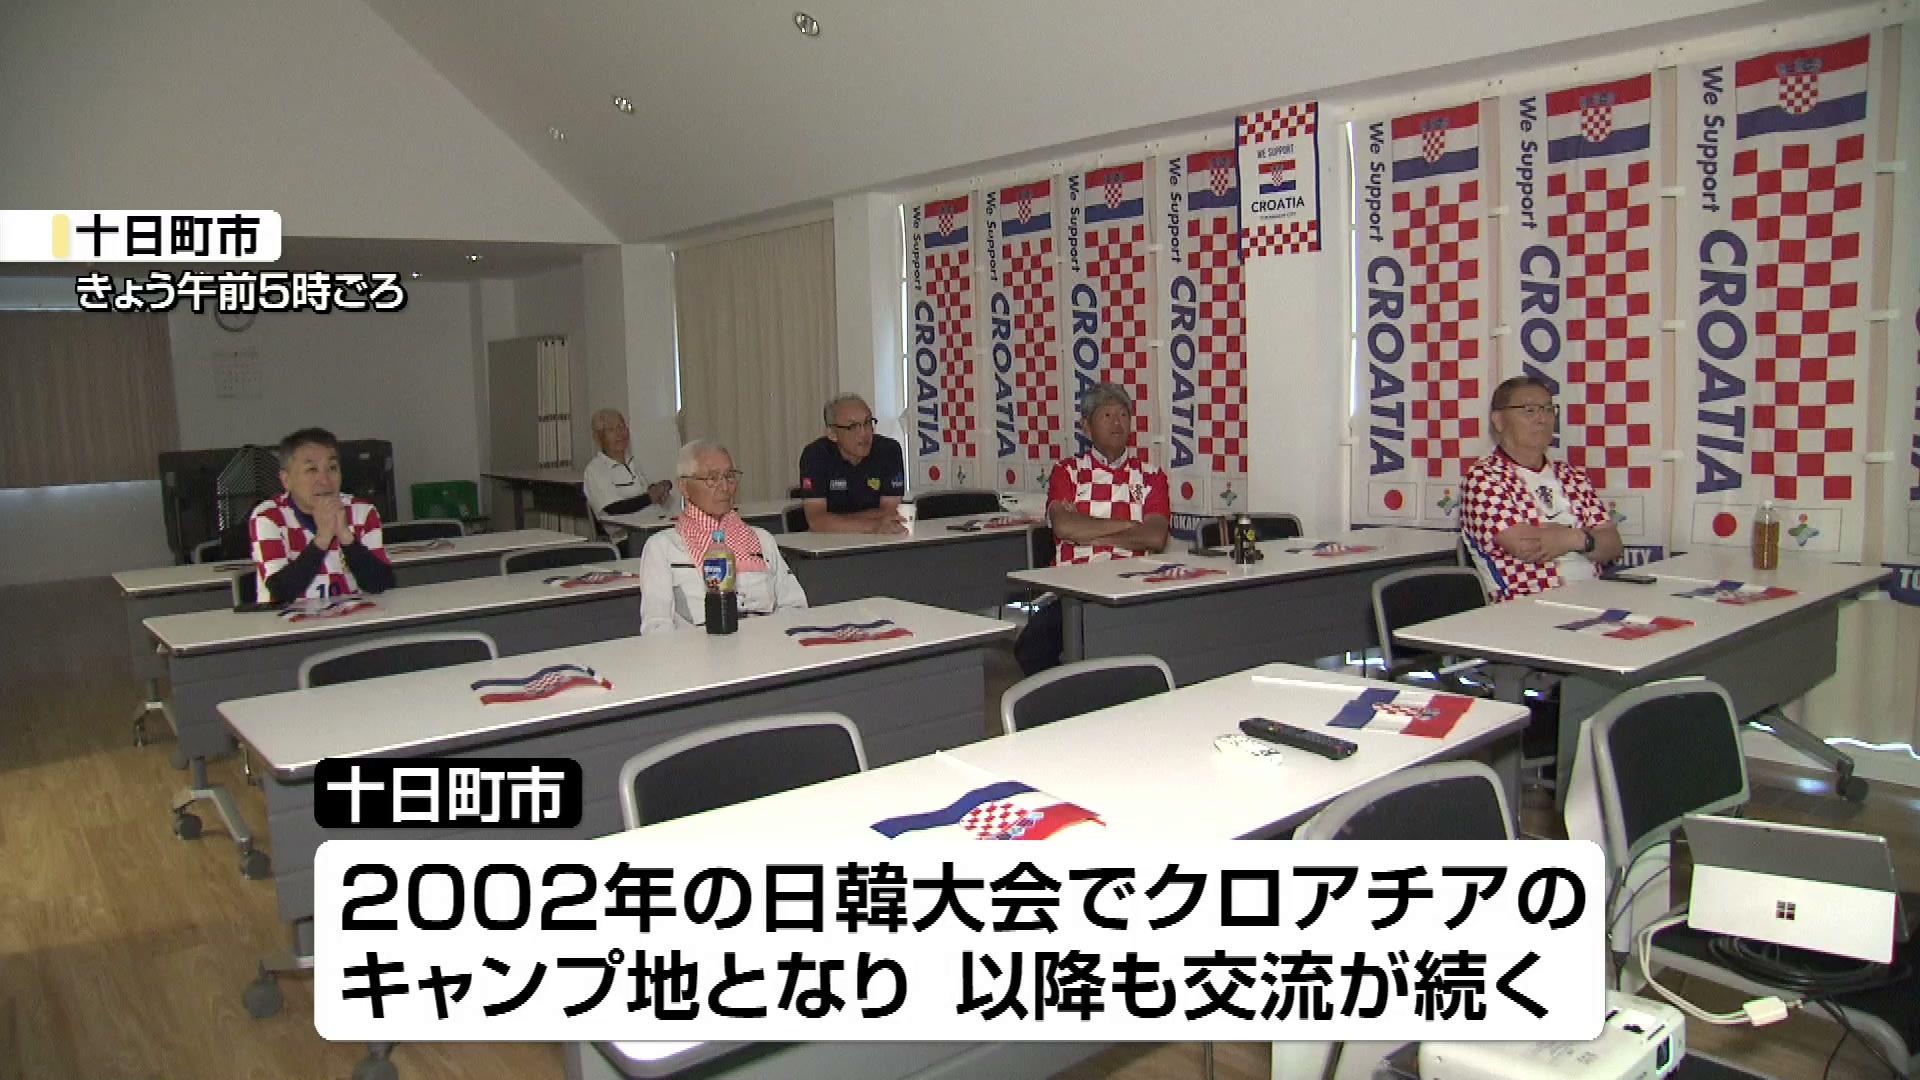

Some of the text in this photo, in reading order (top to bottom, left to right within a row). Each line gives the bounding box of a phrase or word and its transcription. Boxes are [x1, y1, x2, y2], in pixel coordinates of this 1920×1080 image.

[1251, 195, 1306, 213] CROATIA
[1365, 121, 1386, 242] We Support
[1515, 96, 1538, 230] We Support
[1696, 65, 1726, 213] We Support
[986, 191, 998, 282] We Support
[1067, 175, 1081, 272] We Support
[1167, 156, 1182, 264] We Support
[914, 300, 940, 457] CROATIA
[990, 291, 1017, 458] CROATIA
[1170, 275, 1197, 469] CROATIA
[1367, 255, 1405, 476] CROATIA
[1696, 229, 1749, 494] CROATIA
[1617, 547, 1652, 567] ITY
